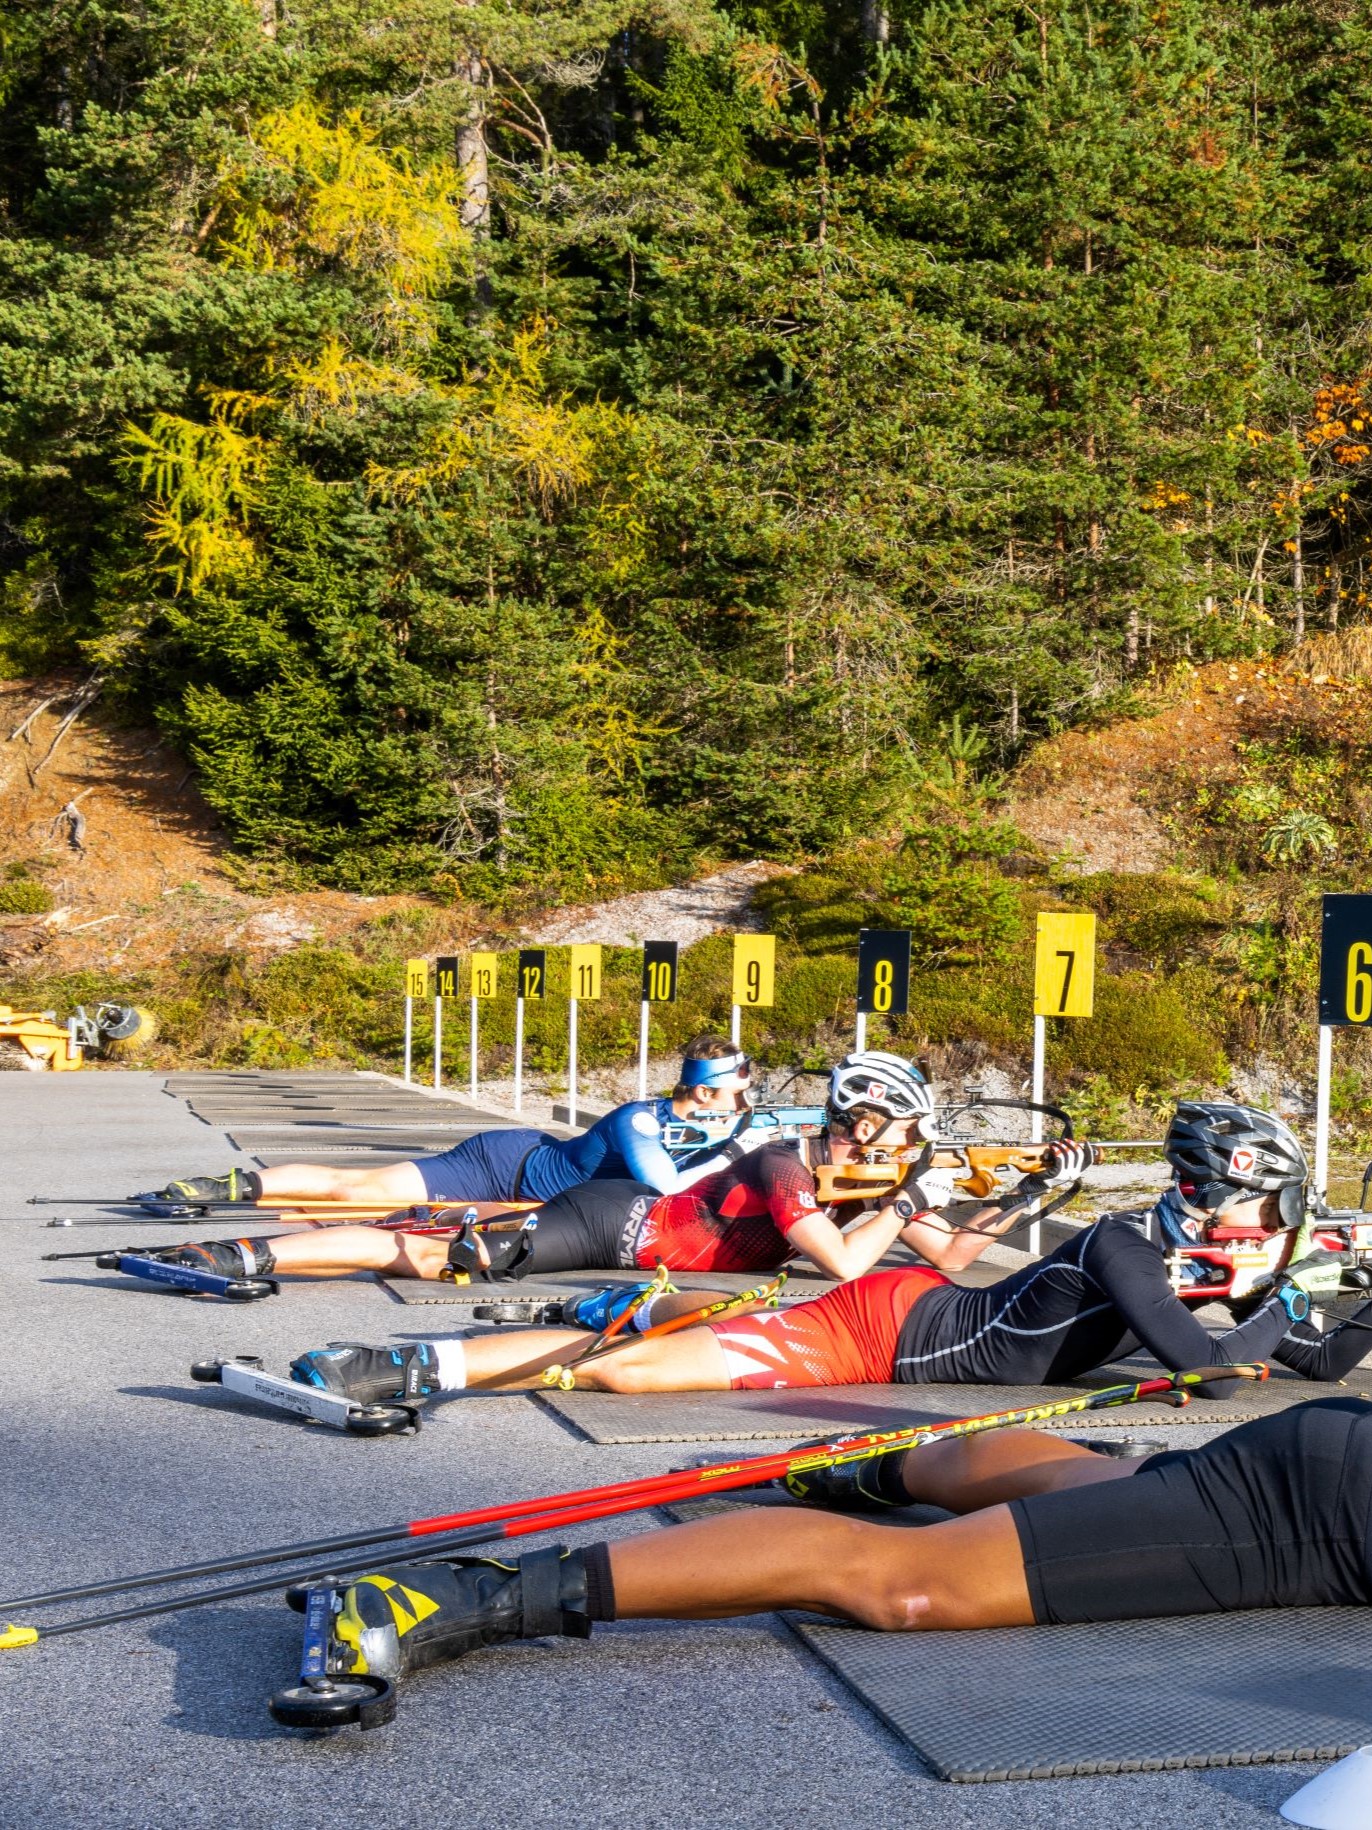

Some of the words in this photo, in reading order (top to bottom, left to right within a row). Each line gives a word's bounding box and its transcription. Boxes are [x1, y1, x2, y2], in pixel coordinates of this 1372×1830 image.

[411, 973, 423, 996] 15
[439, 970, 454, 996] 14
[476, 969, 491, 996] 13
[523, 966, 540, 998] 12
[578, 964, 593, 998] 11
[648, 962, 671, 1001] 10
[747, 960, 760, 1003] 9
[873, 960, 893, 1012] 8
[1056, 950, 1075, 1012] 7
[1346, 941, 1372, 1023] 6
